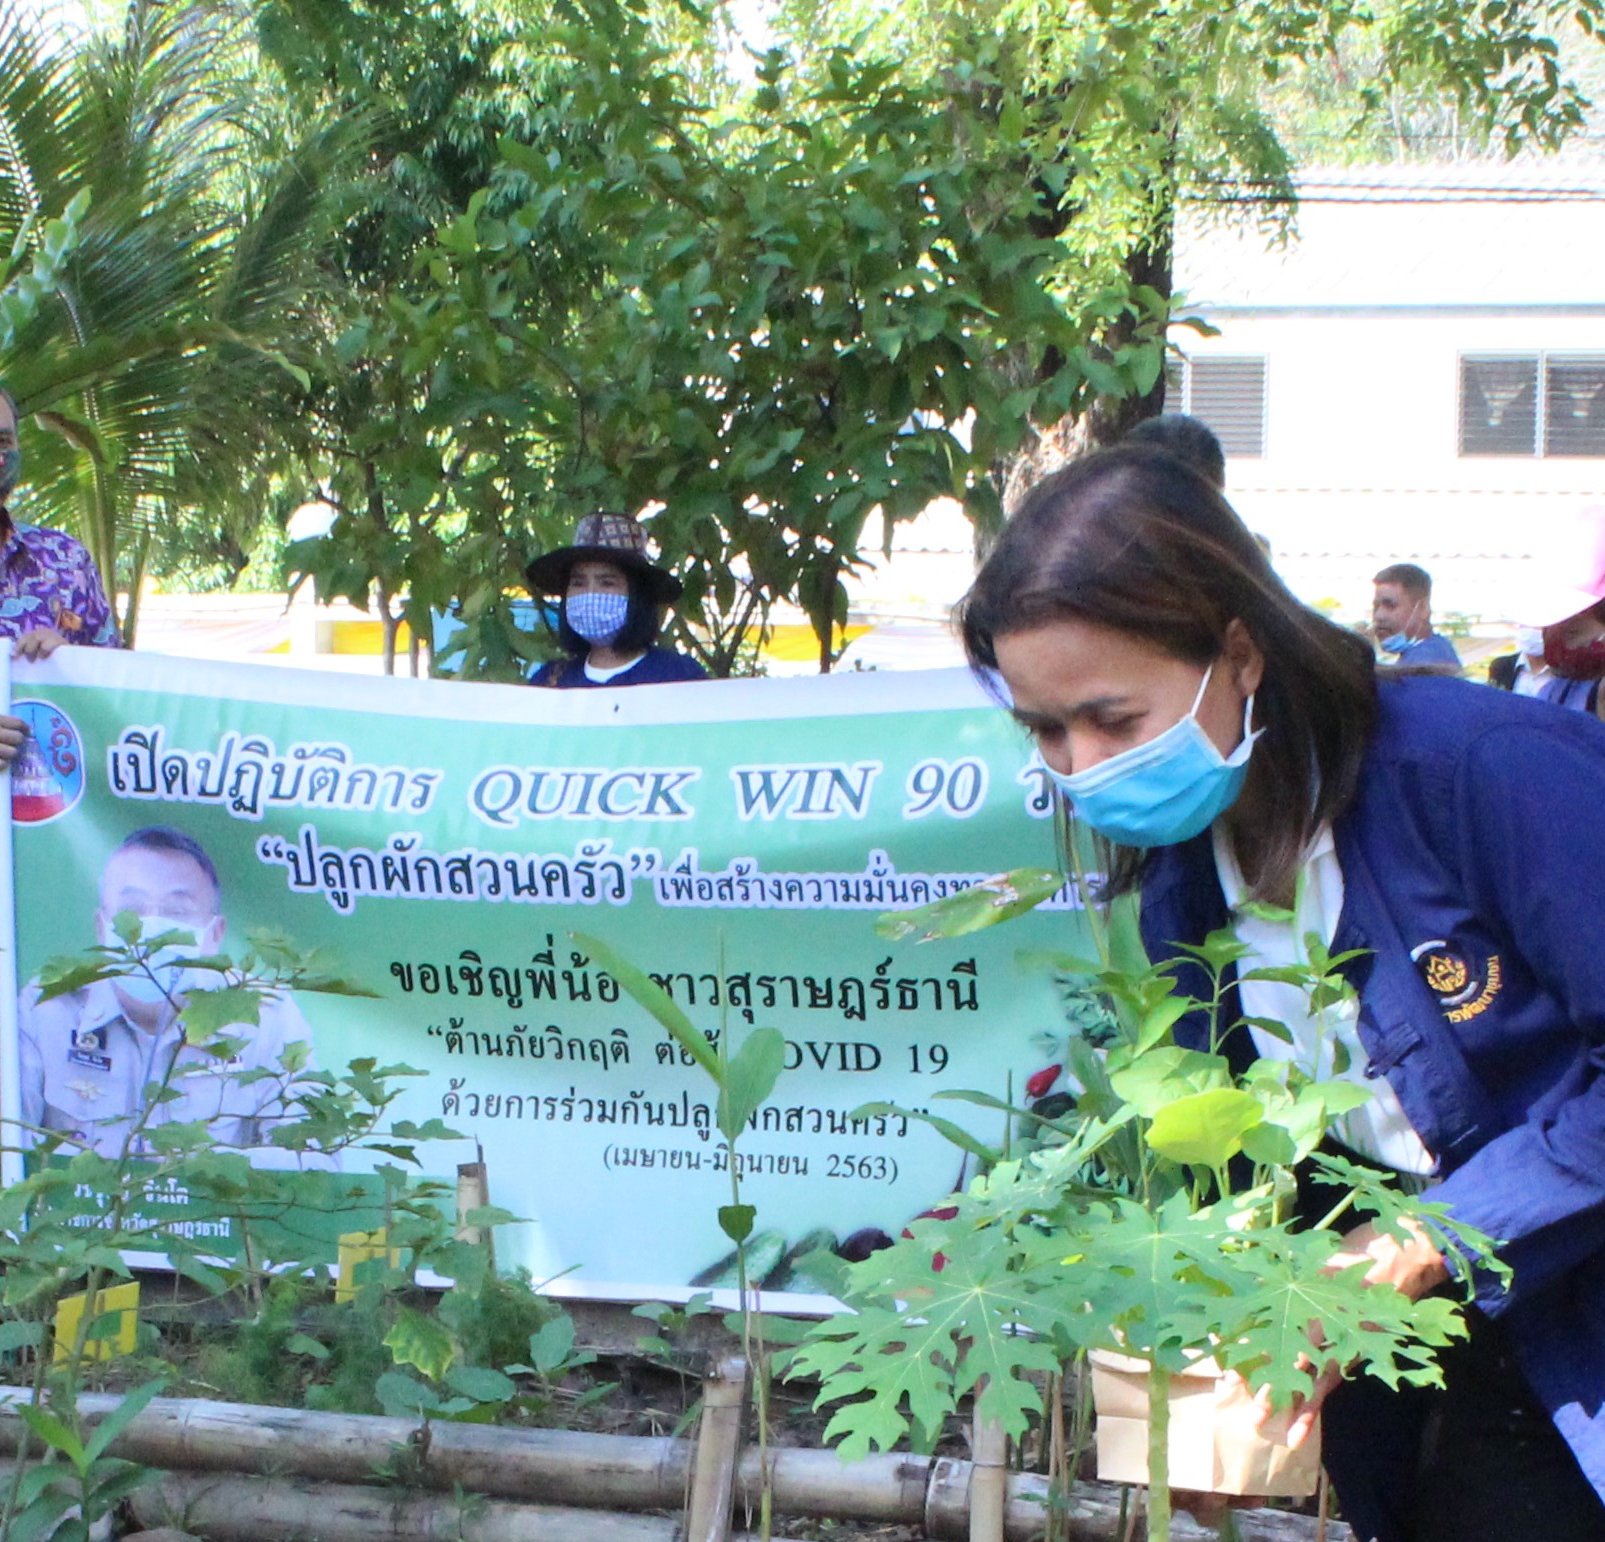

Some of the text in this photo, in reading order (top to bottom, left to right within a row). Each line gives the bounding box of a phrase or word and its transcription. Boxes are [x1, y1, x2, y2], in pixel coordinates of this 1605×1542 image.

[111, 730, 439, 814] เปิดปฏิบัติการ
[473, 769, 695, 824] QUICK
[735, 767, 877, 815] WIN
[908, 762, 983, 813] 90
[783, 1040, 882, 1072] OVID
[908, 1043, 949, 1074] 19
[826, 1153, 899, 1185] 2563)
